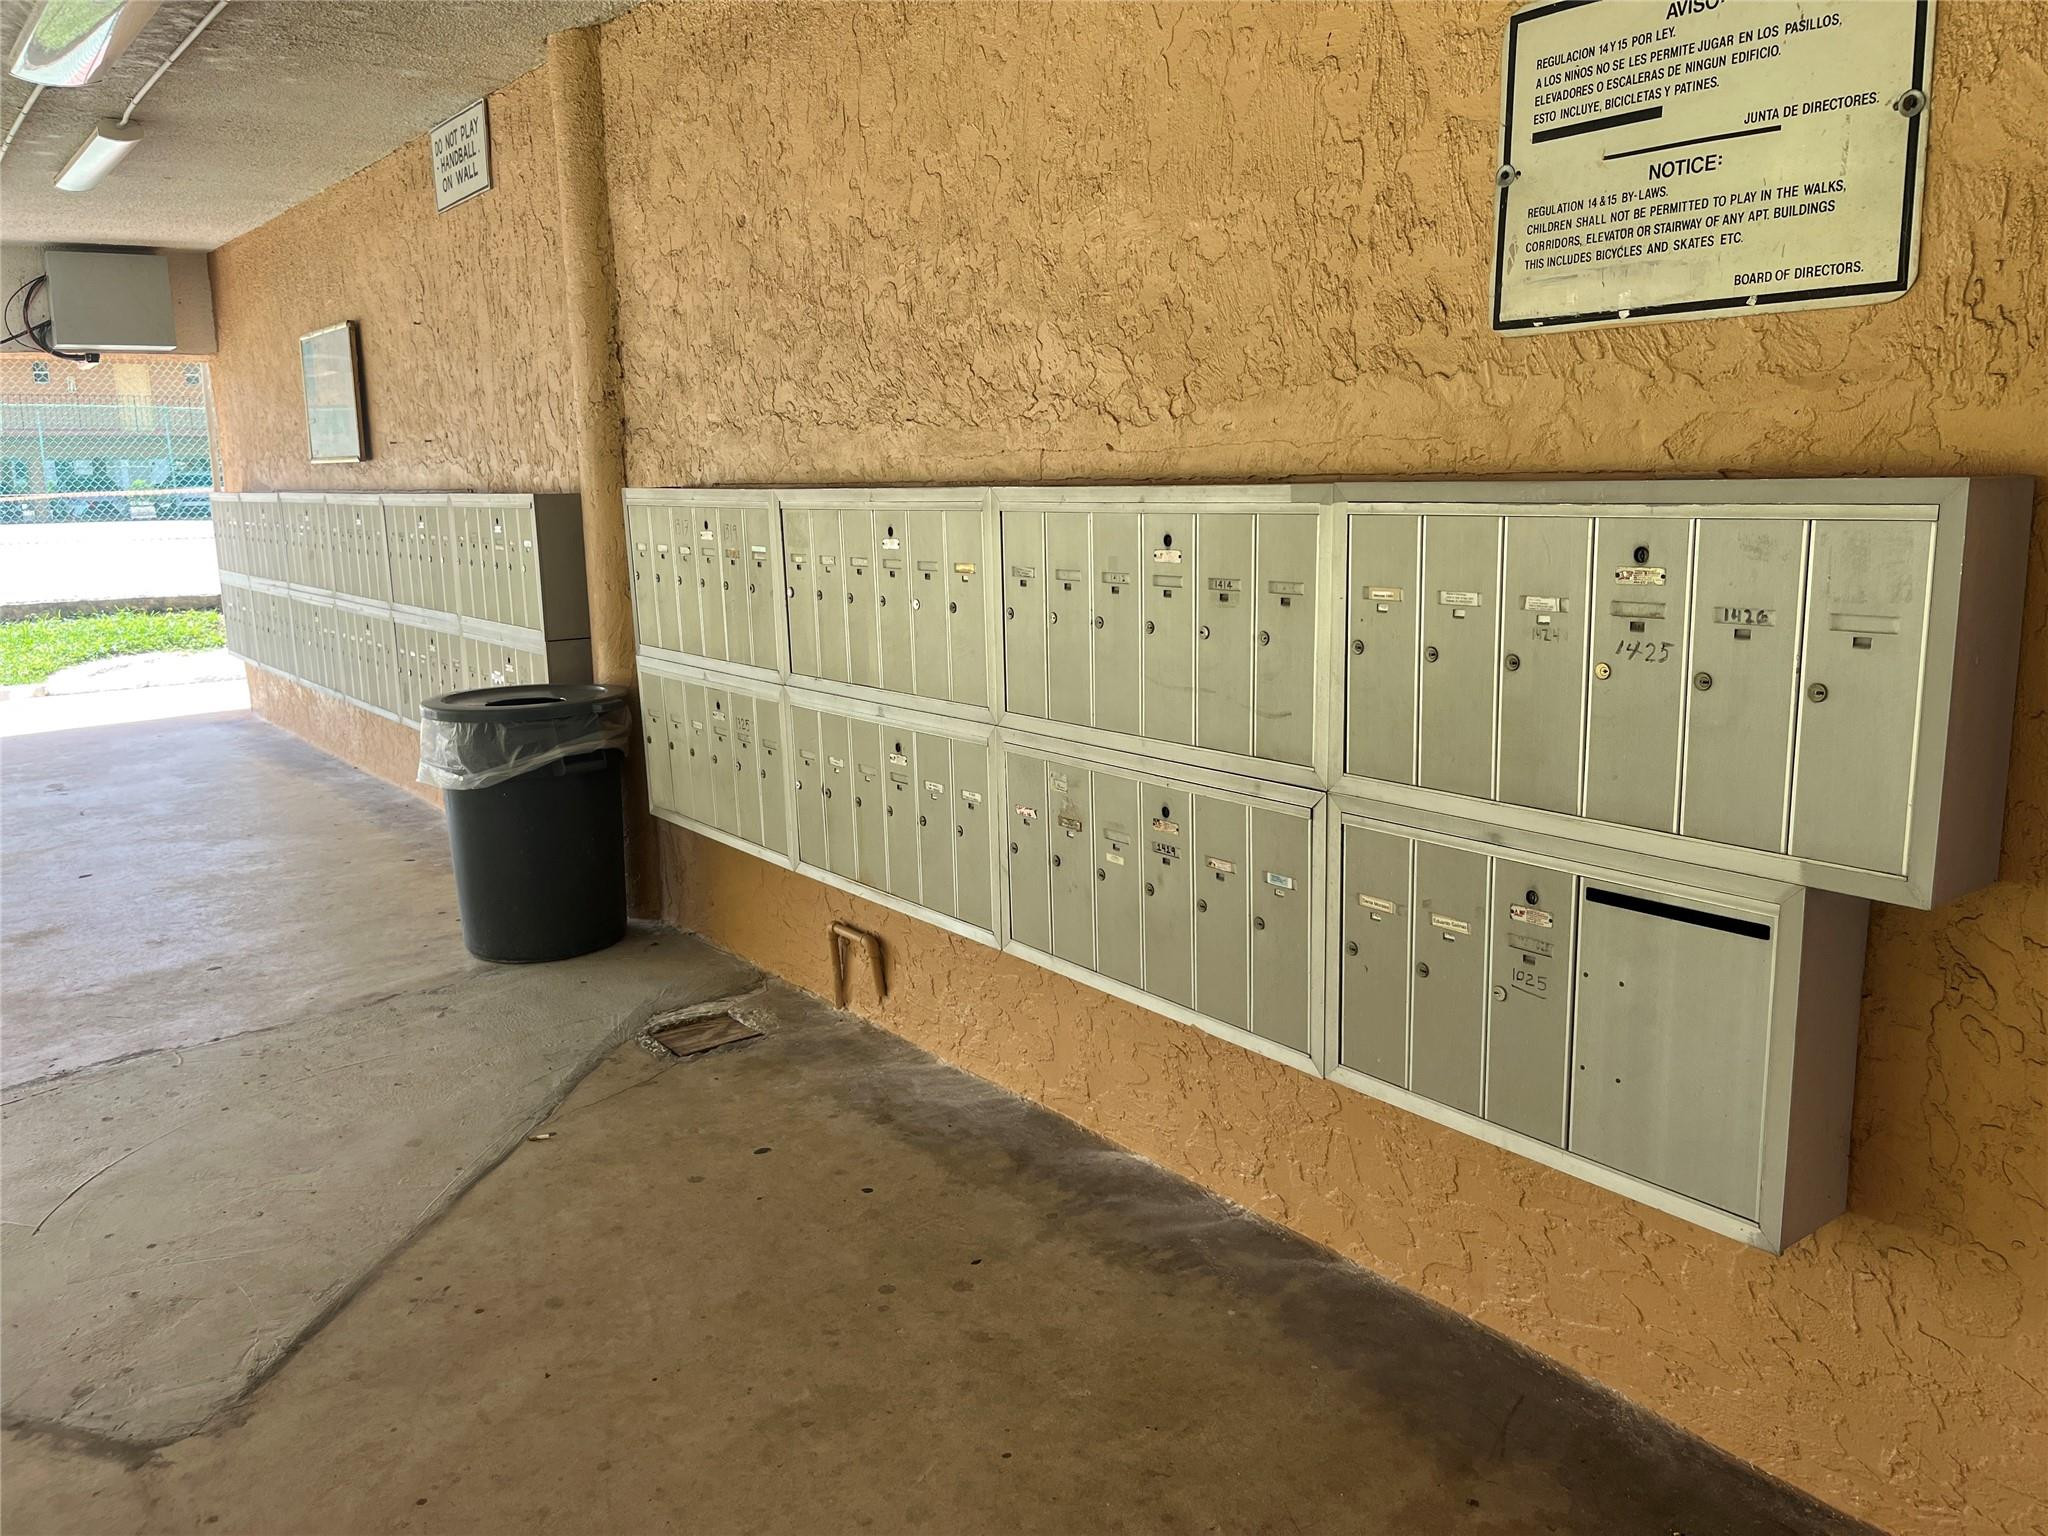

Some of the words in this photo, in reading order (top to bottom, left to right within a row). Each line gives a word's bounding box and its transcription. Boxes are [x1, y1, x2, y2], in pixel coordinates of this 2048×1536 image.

[1536, 46, 1595, 70] REGULACION
[1632, 32, 1652, 47] POR
[1656, 26, 1676, 41] LEY.
[1536, 78, 1542, 89] A
[1544, 74, 1561, 87] LOS
[1564, 65, 1593, 82] NIÑOS
[1596, 62, 1610, 75] NO
[1613, 58, 1625, 70] SE
[1629, 54, 1647, 67] LES
[1650, 43, 1695, 62] PERMITE
[1697, 35, 1734, 53] JUGAR
[1738, 30, 1753, 44] EN
[1758, 25, 1779, 40] LOS
[1535, 84, 1594, 107] ELEVADORES
[1597, 82, 1604, 92] O
[1607, 68, 1664, 90] ESCALERAS
[1668, 64, 1681, 76] DE
[1685, 56, 1726, 73] NINGUN
[1732, 45, 1781, 64] EDIFICIO.
[1534, 111, 1556, 125] ESTO
[1560, 101, 1602, 119] INCLUYE,
[1605, 88, 1662, 110] BICICLETAS
[1664, 86, 1670, 97] Y
[1674, 76, 1719, 95] PATINES.
[1744, 108, 1779, 124] JUNTA
[1784, 105, 1798, 118] DE
[435, 139, 442, 157] DO
[445, 129, 457, 151] NOT
[460, 116, 478, 141] PLAY
[440, 141, 476, 173] HANDBALL
[1649, 154, 1722, 180] NOTICE:
[442, 174, 453, 192] ON
[455, 162, 478, 184] WALL
[1527, 220, 1572, 235] CHILDREN
[1576, 214, 1606, 228] SHALL
[1610, 210, 1630, 222] NOT
[1634, 207, 1646, 219] BE
[1650, 198, 1709, 216] PERMITTED
[1713, 196, 1726, 207] TO
[1730, 191, 1757, 205] PLAY
[1760, 189, 1771, 201] IN
[1777, 185, 1799, 198] THE
[1804, 180, 1846, 195] WALKS,
[1528, 200, 1584, 218] REGULATION
[1622, 186, 1668, 203] BY-LAWS.
[1526, 236, 1582, 252] CORRIDORS,
[1586, 228, 1633, 244] ELEVATOR
[1637, 225, 1650, 237] OR
[1654, 219, 1701, 235] STAIRWAY
[1706, 215, 1719, 227] OF
[1722, 212, 1744, 225] ANY
[1748, 209, 1769, 221] APT.
[1774, 200, 1835, 218] BUILDINGS
[1525, 258, 1544, 270] THIS
[1547, 252, 1592, 267] INCLUDES
[1596, 245, 1642, 260] BICYCLES
[1647, 242, 1668, 254] AND
[1674, 235, 1714, 250] SKATES
[1720, 232, 1743, 245] ETC.
[1734, 271, 1772, 286] BOARD
[1775, 269, 1790, 281] OF
[1795, 260, 1863, 279] DIRECTORS.
[1214, 580, 1232, 589] 1414
[1615, 640, 1675, 663] 1425
[1156, 843, 1176, 857] 1419
[1512, 967, 1548, 992] 1025
